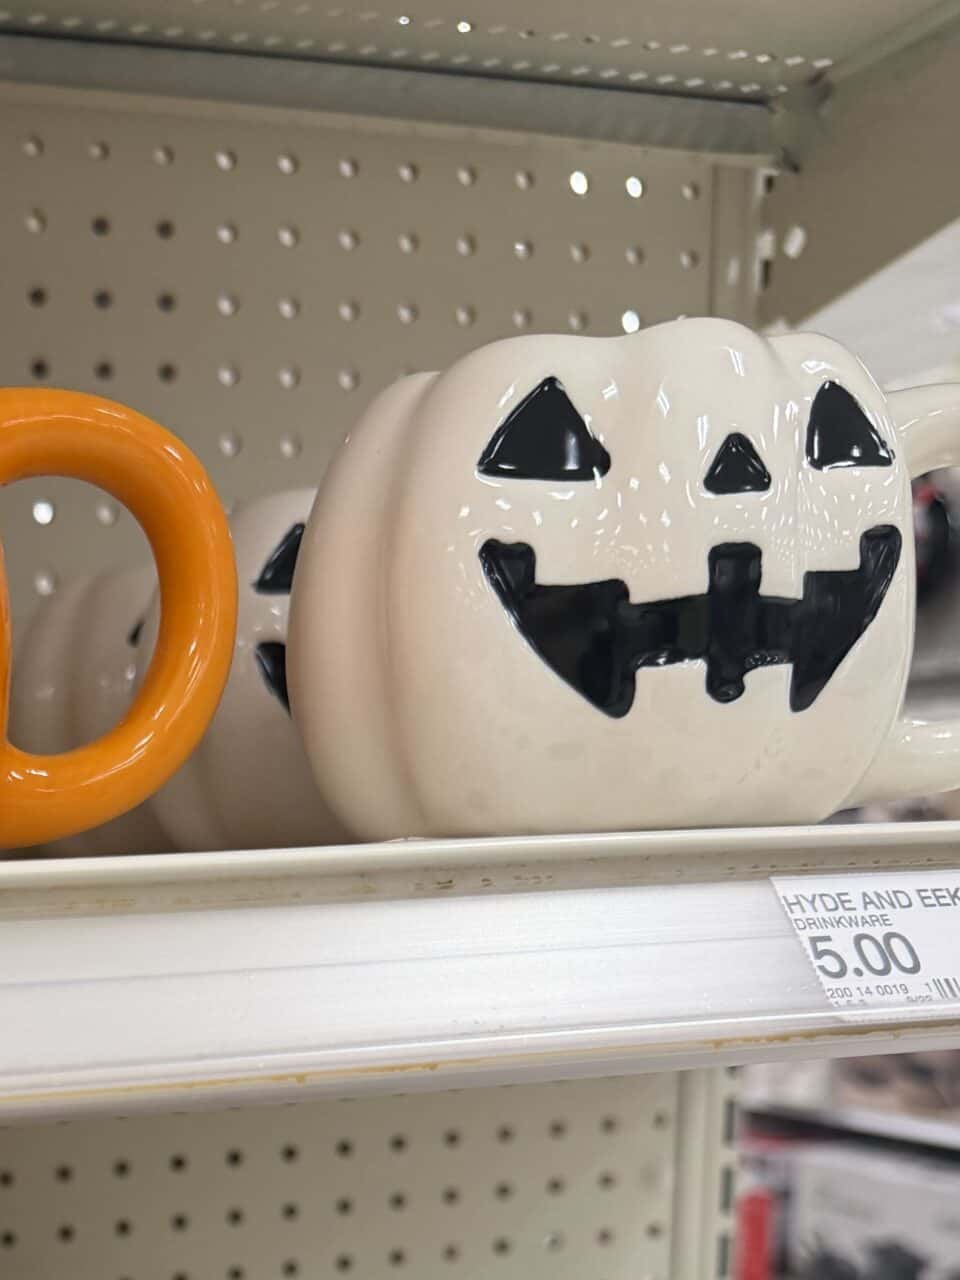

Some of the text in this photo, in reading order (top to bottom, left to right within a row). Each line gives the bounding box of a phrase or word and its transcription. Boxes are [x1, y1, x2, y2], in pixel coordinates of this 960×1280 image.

[782, 891, 857, 914] HYDE
[863, 889, 913, 911] AND
[793, 913, 894, 931] DRINKWARE
[807, 931, 921, 979] 5.00
[827, 987, 853, 999] 200
[856, 985, 872, 997] 14
[875, 983, 909, 996] 0019
